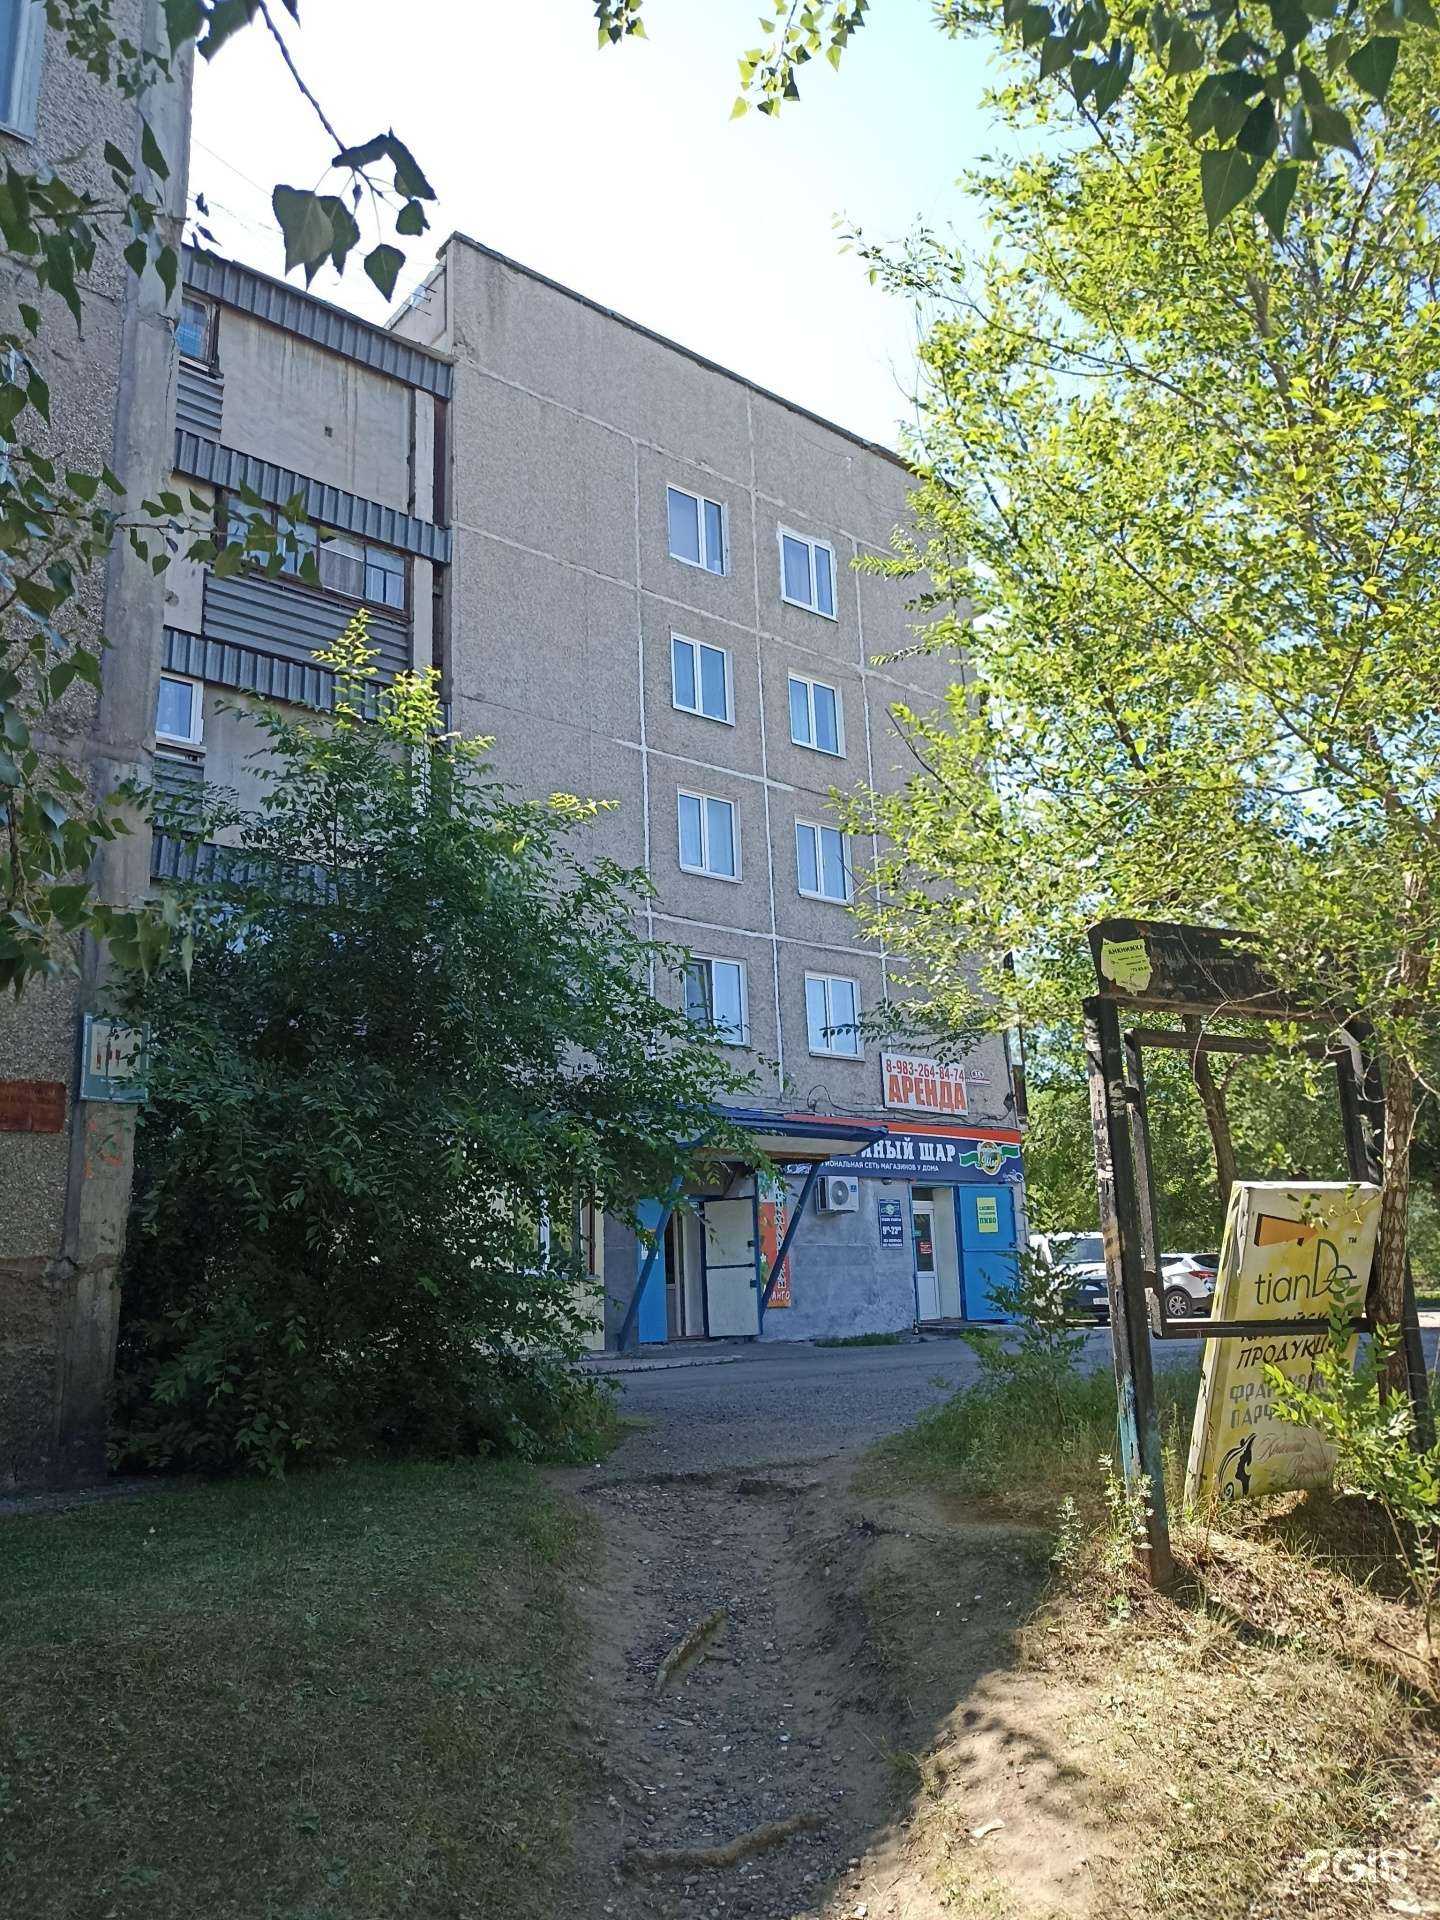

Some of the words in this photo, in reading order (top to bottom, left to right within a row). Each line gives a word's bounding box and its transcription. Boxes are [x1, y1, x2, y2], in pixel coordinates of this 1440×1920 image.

[886, 1059, 964, 1081] 8-983-264-84-74
[889, 1074, 966, 1112] АРЕНДА
[919, 1142, 956, 1162] ШАР
[821, 1160, 864, 1170] ИОНАЛЬНАЯ
[881, 1162, 917, 1171] МАГАЗИНОВ
[922, 1164, 939, 1172] ДОМА
[1254, 1238, 1358, 1306] tianDe
[771, 1290, 791, 1301] АНГО
